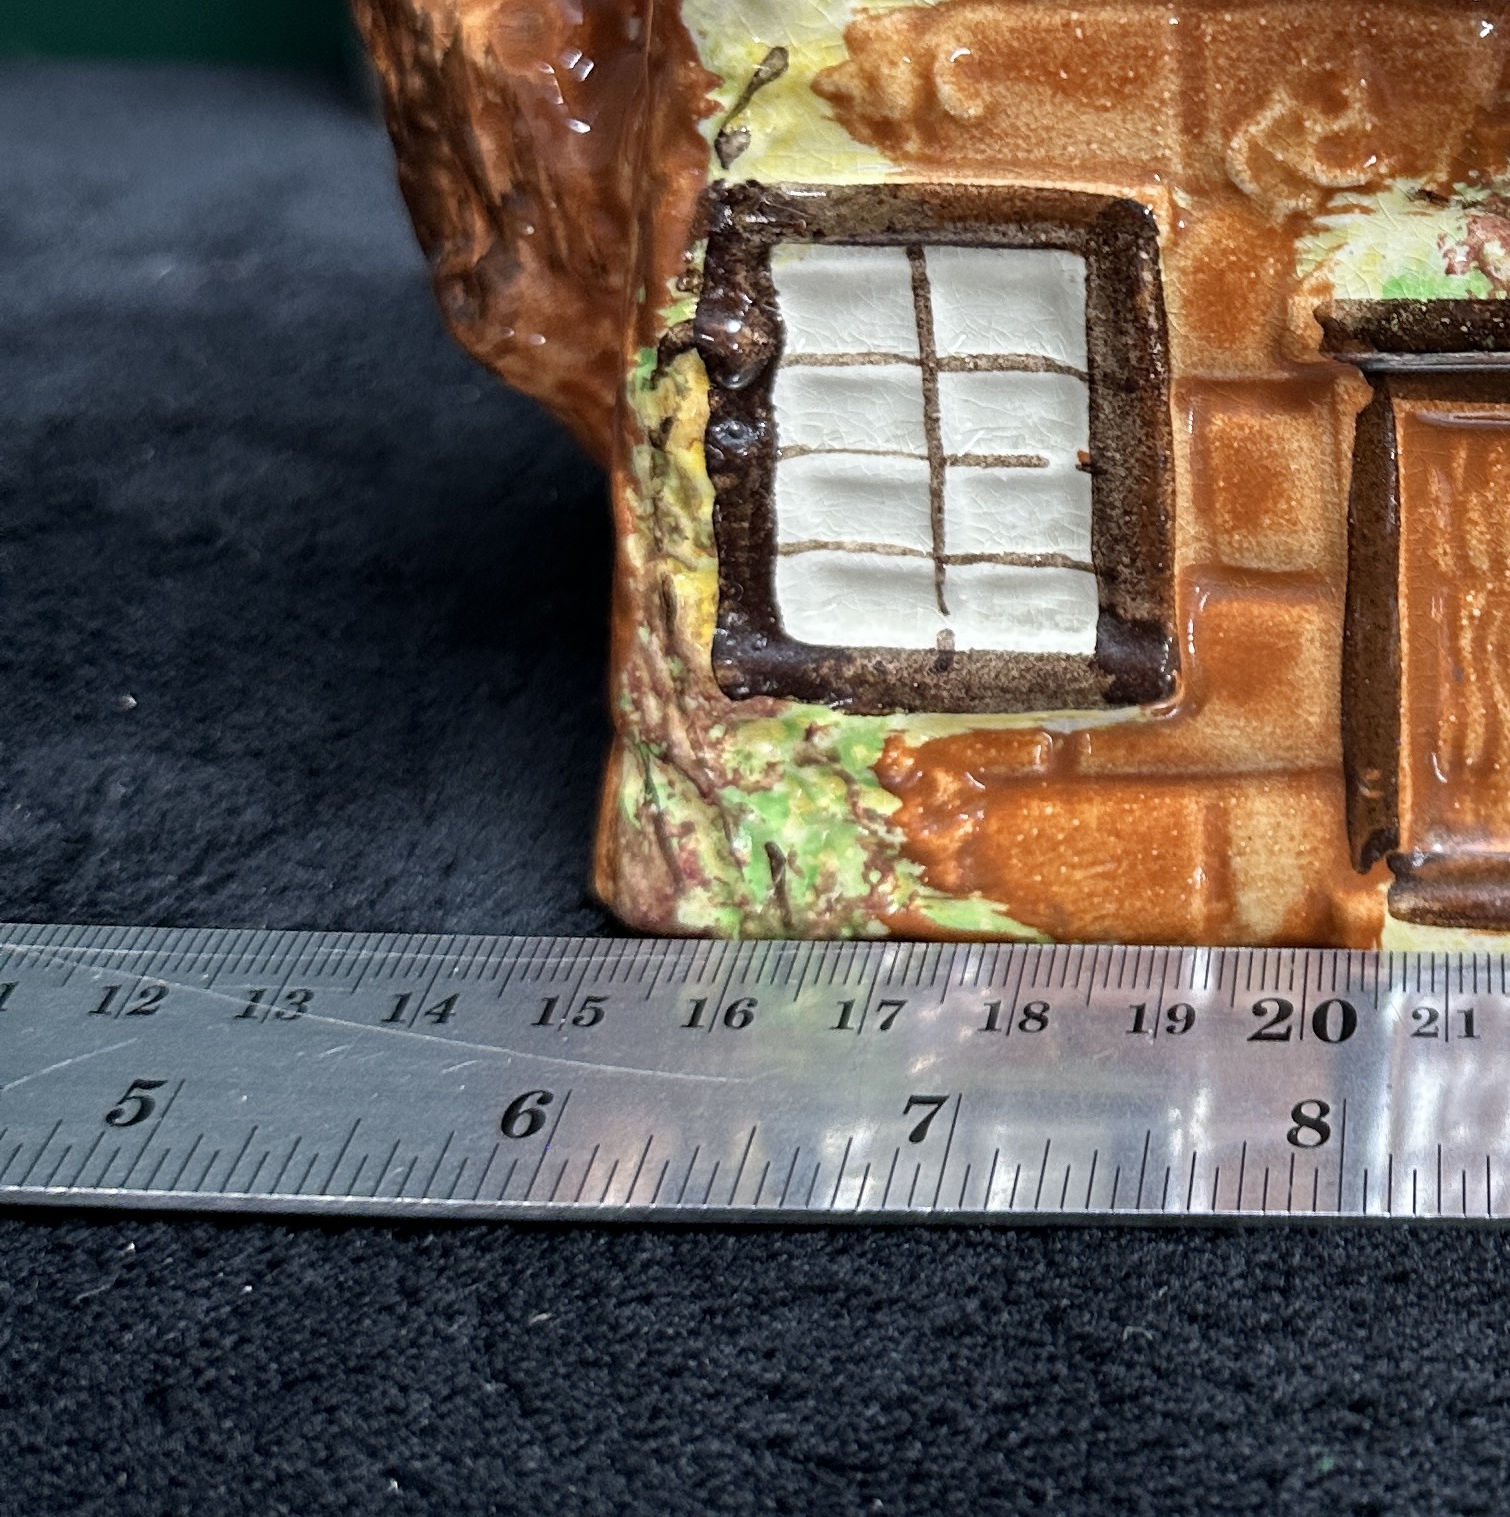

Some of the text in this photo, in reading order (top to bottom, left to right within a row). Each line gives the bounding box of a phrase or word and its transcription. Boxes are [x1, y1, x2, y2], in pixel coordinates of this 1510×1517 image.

[88, 983, 169, 1017] 12
[234, 987, 315, 1021] 13
[380, 991, 458, 1025] 14
[531, 995, 608, 1029] 15
[680, 997, 758, 1030] 16
[829, 998, 906, 1031] 17
[977, 1000, 1050, 1034] 18
[1125, 1002, 1197, 1036] 19
[1247, 997, 1358, 1043] 20
[1411, 1006, 1480, 1039] 21
[105, 1079, 167, 1127] 5
[501, 1089, 555, 1139] 6
[903, 1094, 949, 1144] 7
[1287, 1098, 1331, 1149] 8
